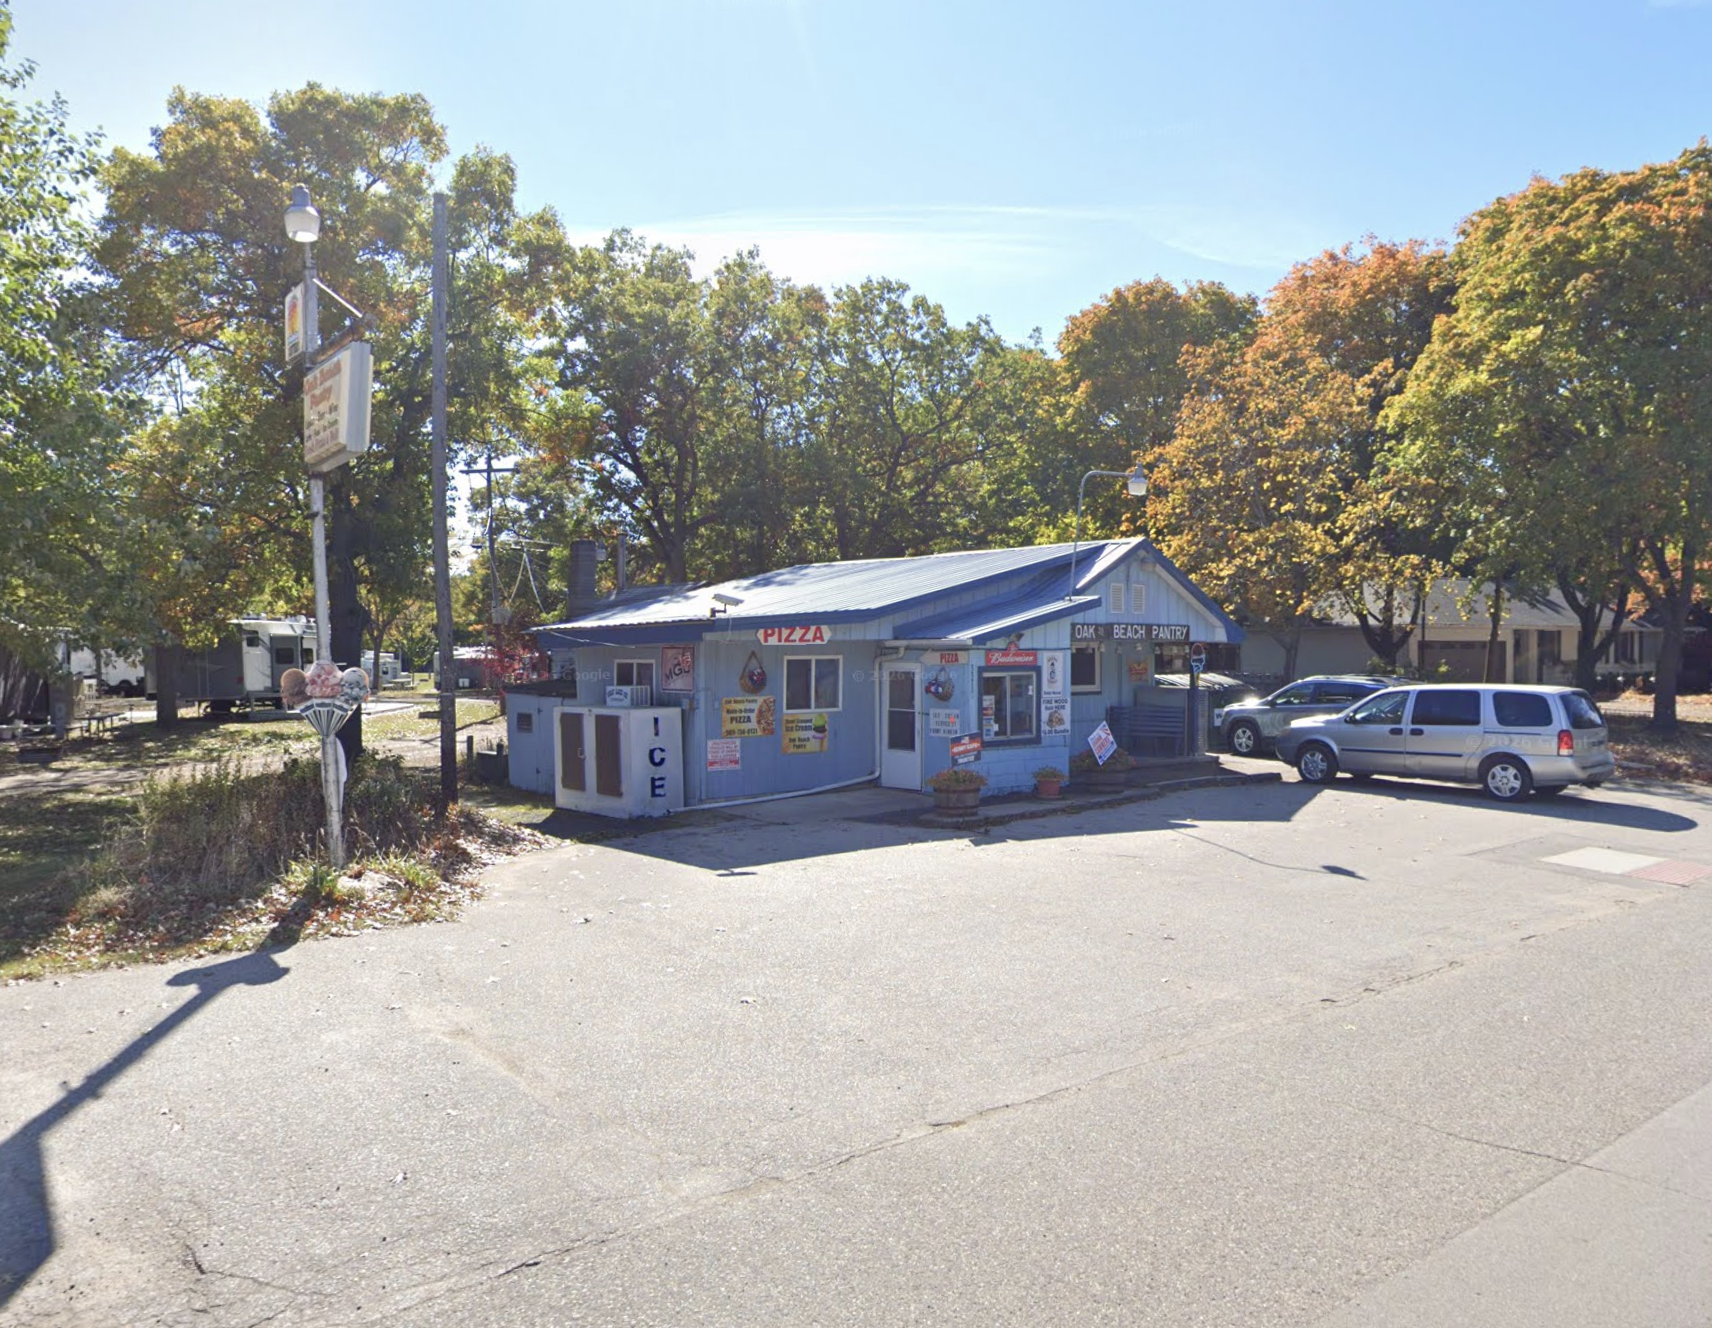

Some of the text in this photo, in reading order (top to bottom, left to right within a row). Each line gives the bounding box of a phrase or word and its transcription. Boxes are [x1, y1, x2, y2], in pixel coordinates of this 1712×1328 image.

[763, 625, 825, 643] PIZZA
[1075, 624, 1188, 640] OAK BEACH PANTRY
[939, 652, 959, 664] PIZZA
[989, 652, 1034, 664] Budweiser
[730, 715, 752, 724] PIZZA
[795, 724, 813, 732] Cream
[648, 716, 666, 798] ICE
